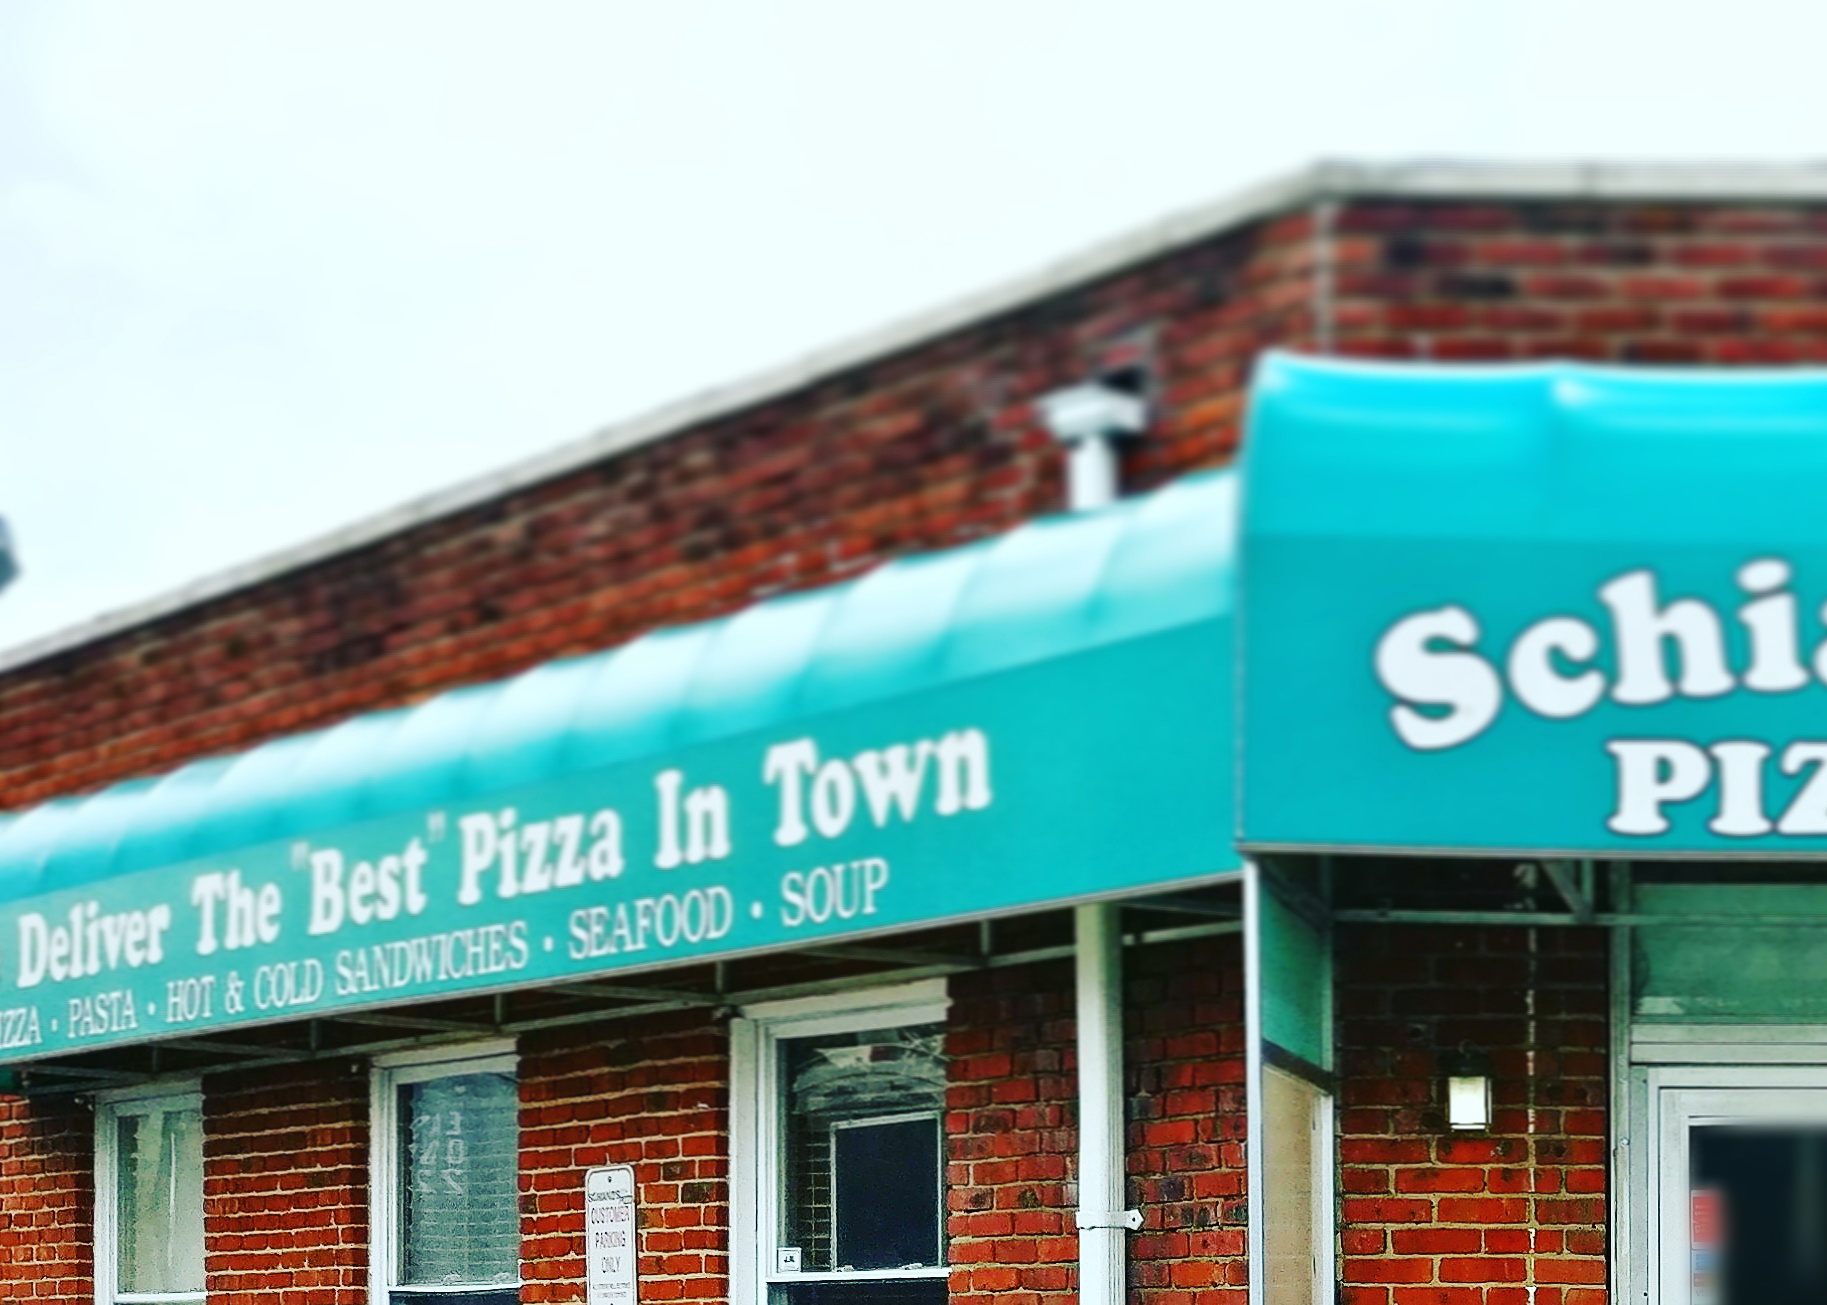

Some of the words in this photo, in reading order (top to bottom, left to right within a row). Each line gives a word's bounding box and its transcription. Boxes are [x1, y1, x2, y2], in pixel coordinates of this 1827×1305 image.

[16, 899, 172, 988] Deliver
[190, 869, 282, 955] The
[458, 807, 624, 905] Pizza
[655, 769, 731, 869] In
[763, 727, 991, 846] Town
[67, 989, 138, 1039] PASTA
[166, 975, 215, 1024] HOT
[225, 970, 245, 1014] &
[254, 958, 323, 1011] COLD
[336, 920, 528, 996] SANDWICHES
[569, 886, 732, 960] SEAFOOD
[782, 858, 888, 927] SOUP
